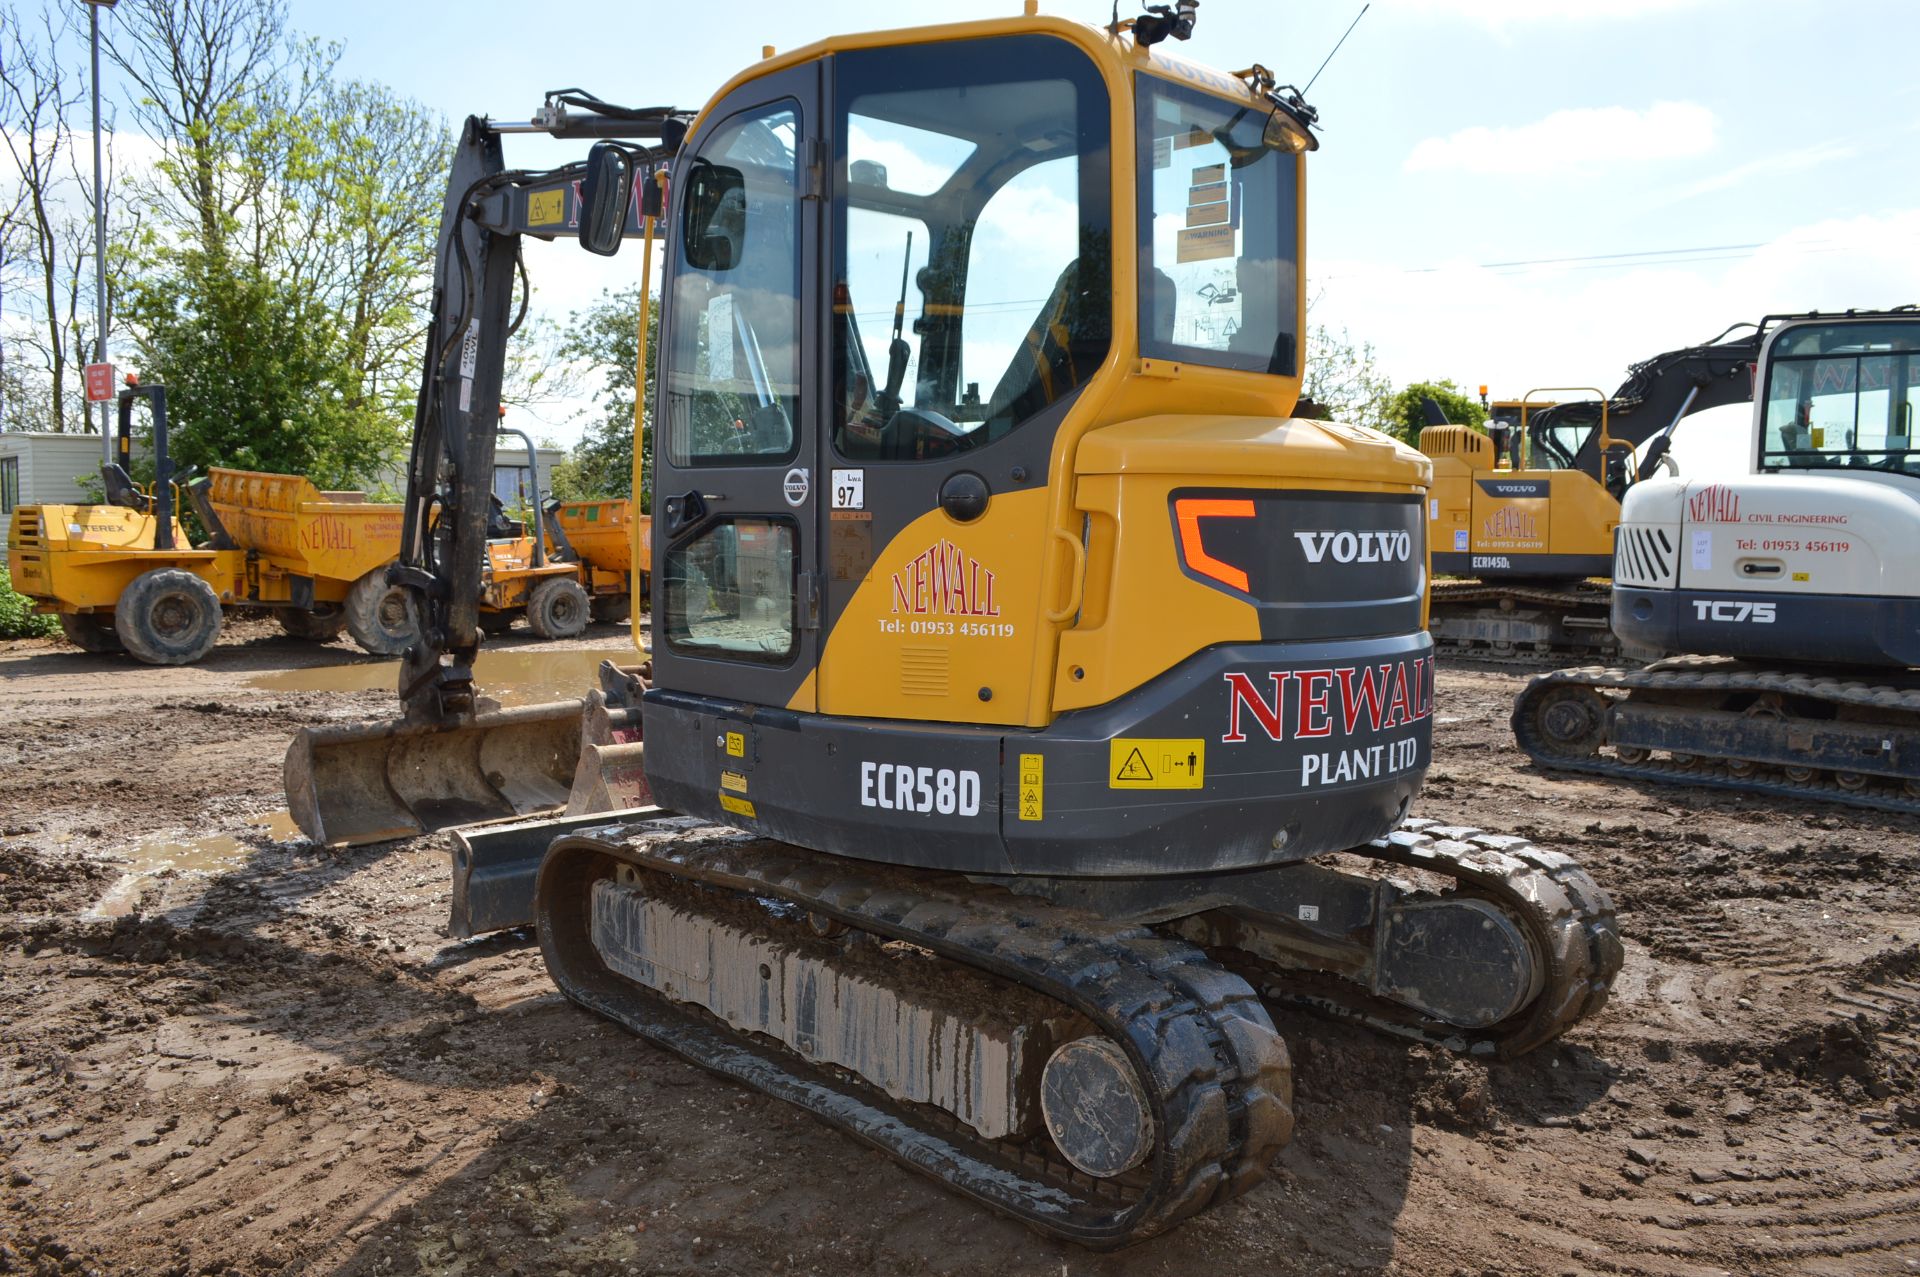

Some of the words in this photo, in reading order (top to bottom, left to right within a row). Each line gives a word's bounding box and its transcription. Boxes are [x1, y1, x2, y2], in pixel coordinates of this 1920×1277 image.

[838, 486, 855, 506] 97
[1496, 485, 1536, 493] VOLVO
[1687, 483, 1741, 522] NEWALL
[1748, 514, 1774, 523] CIVIL
[1777, 514, 1847, 524] ENGINEERING
[301, 513, 355, 549] NEWALL
[1484, 506, 1537, 538] NEWALL
[1294, 529, 1411, 563] VOLVO
[1477, 540, 1490, 548] Tel:
[1736, 539, 1757, 550] Tel:
[1762, 540, 1799, 551] 01953
[1805, 541, 1849, 552] 456119
[892, 538, 1000, 617] NEWALL
[878, 619, 905, 633] Tel:
[910, 621, 954, 635] 01953
[960, 622, 1014, 637] 456119
[1693, 601, 1776, 624] TC75
[1302, 744, 1384, 787] PLANT
[1389, 737, 1417, 773] LTD
[861, 761, 981, 817] ECR58D
